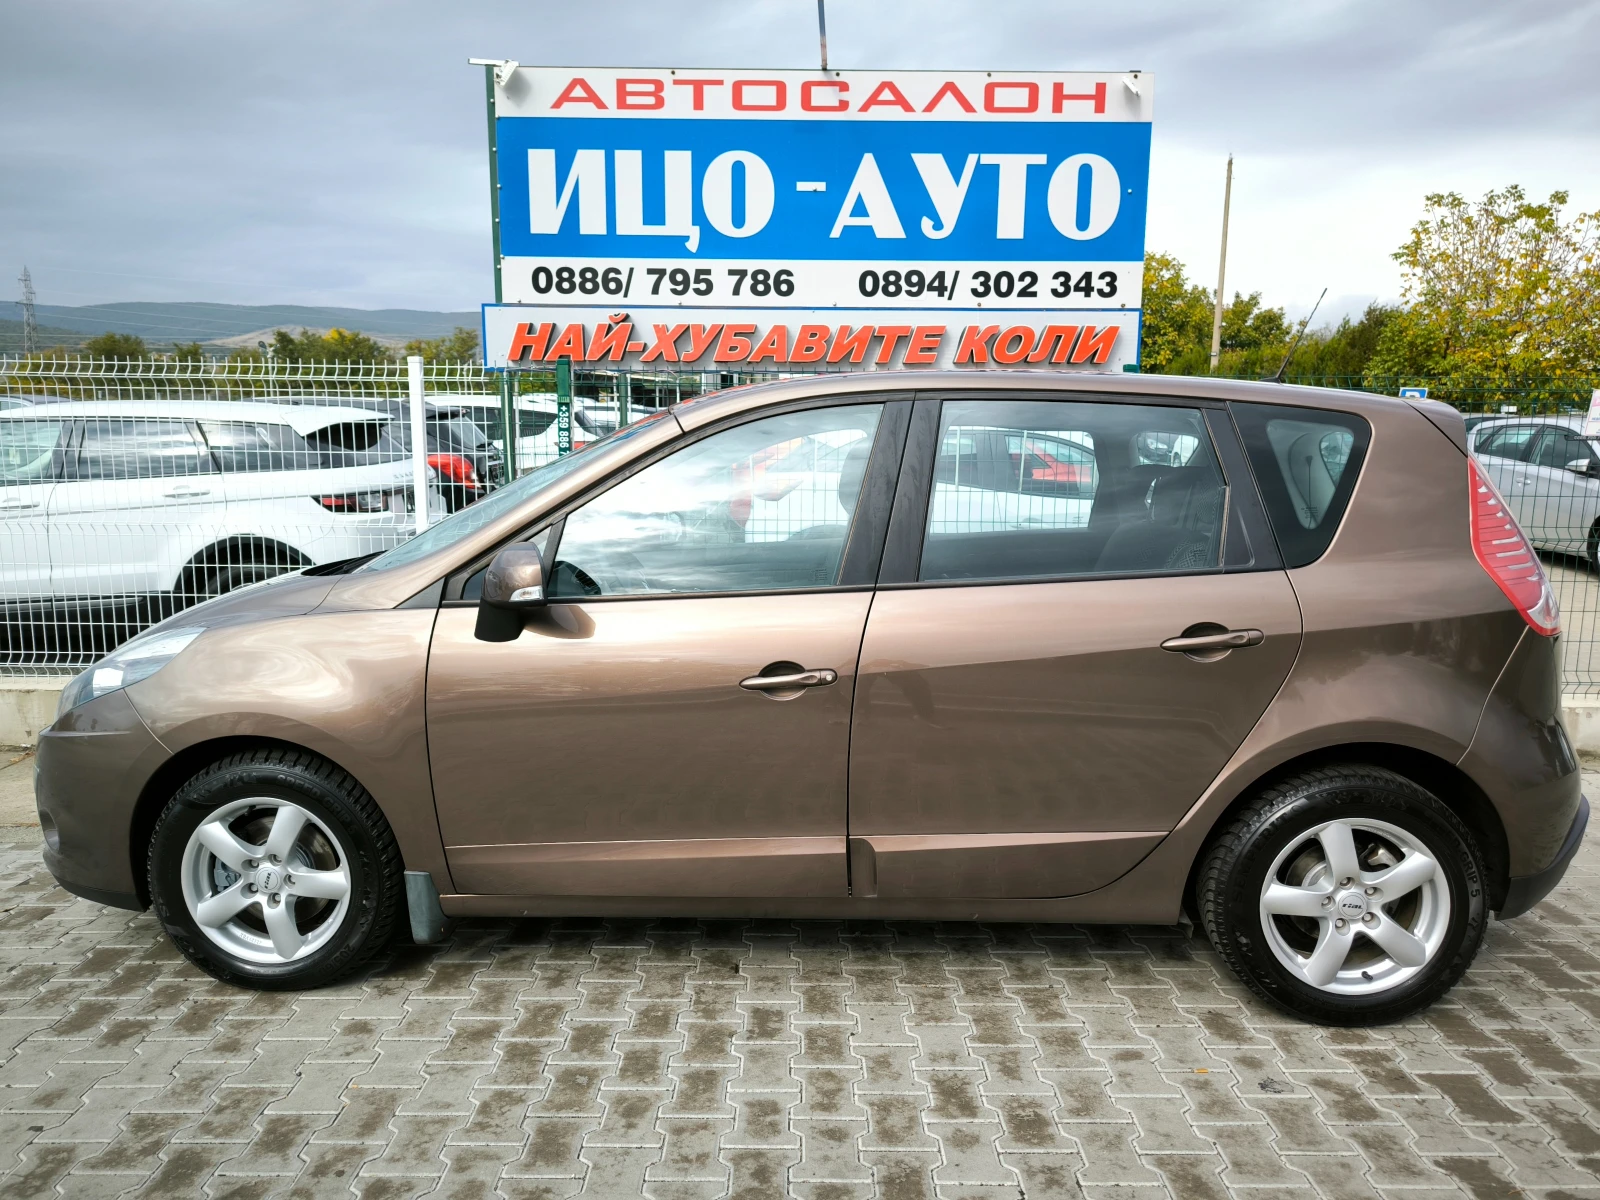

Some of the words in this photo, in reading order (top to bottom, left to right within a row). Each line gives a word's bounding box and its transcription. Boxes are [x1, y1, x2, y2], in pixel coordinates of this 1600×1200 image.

[550, 77, 1107, 114] АВТОСАЛОН
[527, 148, 775, 253] ИЦО
[531, 266, 635, 298] 0886/
[646, 268, 714, 296] 795
[727, 269, 795, 297] 786
[858, 270, 960, 301] 0894/
[970, 270, 1039, 299] 302
[1050, 271, 1118, 299] 343
[507, 312, 947, 365] НАЙ-ХУБАВИТЕ
[955, 325, 1120, 364] КОЛИ
[559, 405, 569, 428] +359
[559, 431, 570, 448] 886
[1470, 888, 1481, 898] 5
